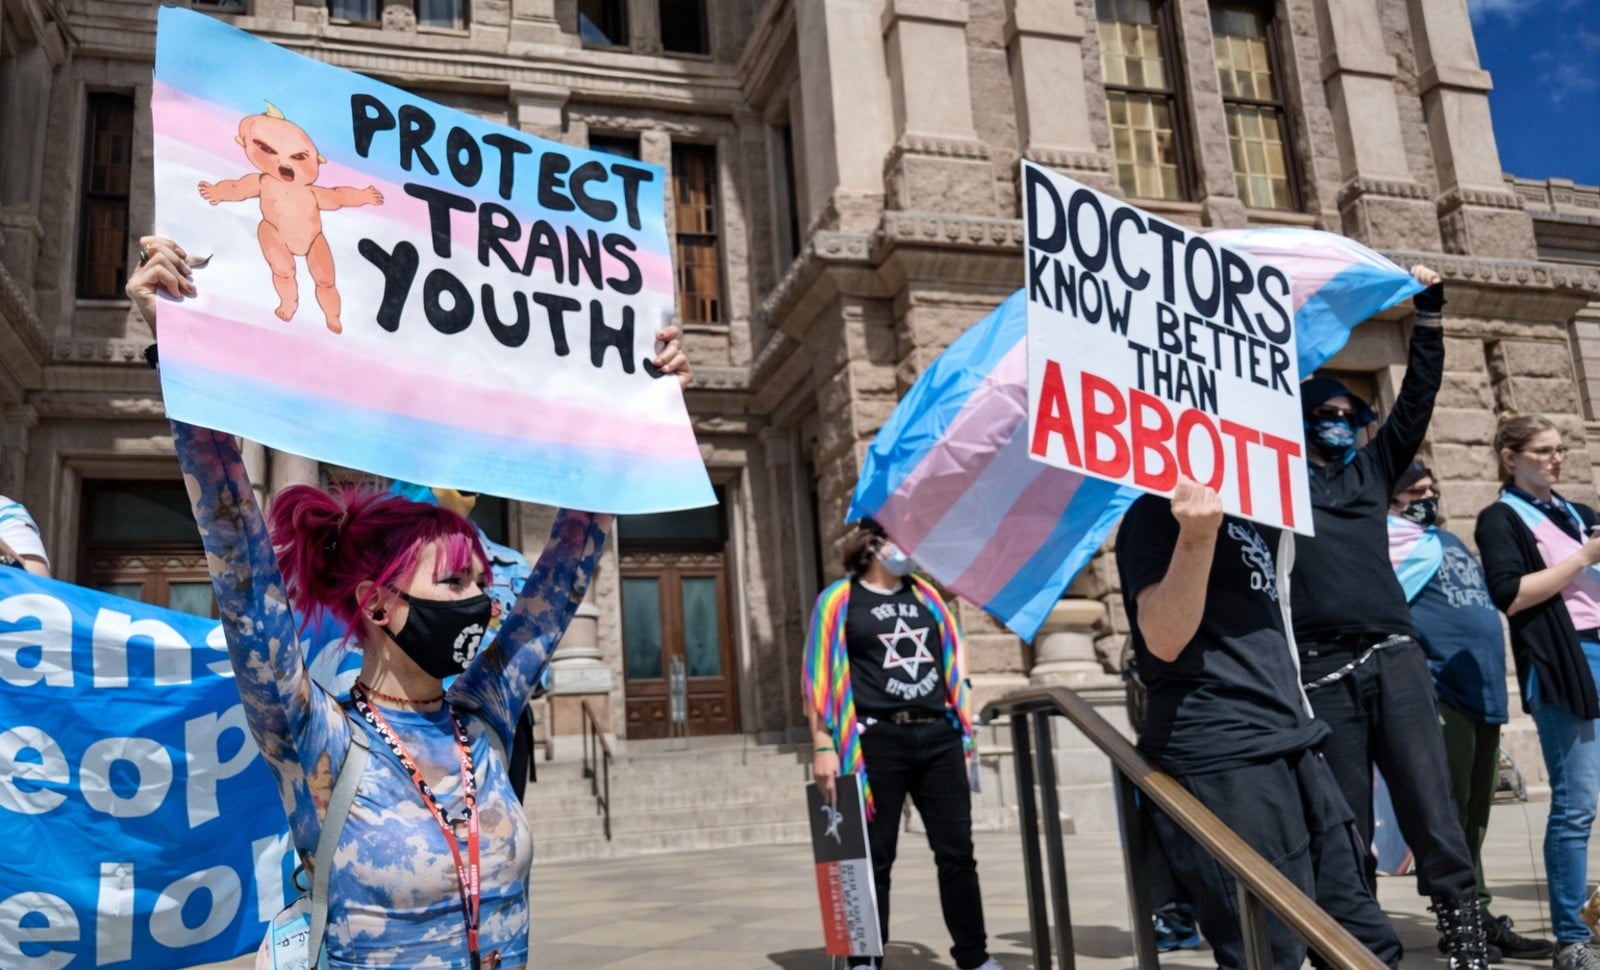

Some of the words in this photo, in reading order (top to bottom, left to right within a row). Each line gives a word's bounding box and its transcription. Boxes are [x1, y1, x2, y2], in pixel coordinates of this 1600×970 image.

[350, 93, 654, 231] PROTECT
[403, 182, 643, 295] TRANS
[1025, 164, 1292, 345] DOCTORS
[1028, 248, 1133, 337] KNOW
[1156, 302, 1295, 397] BETTER
[1128, 341, 1219, 416] THAN
[1030, 359, 1301, 528] ABBOTT
